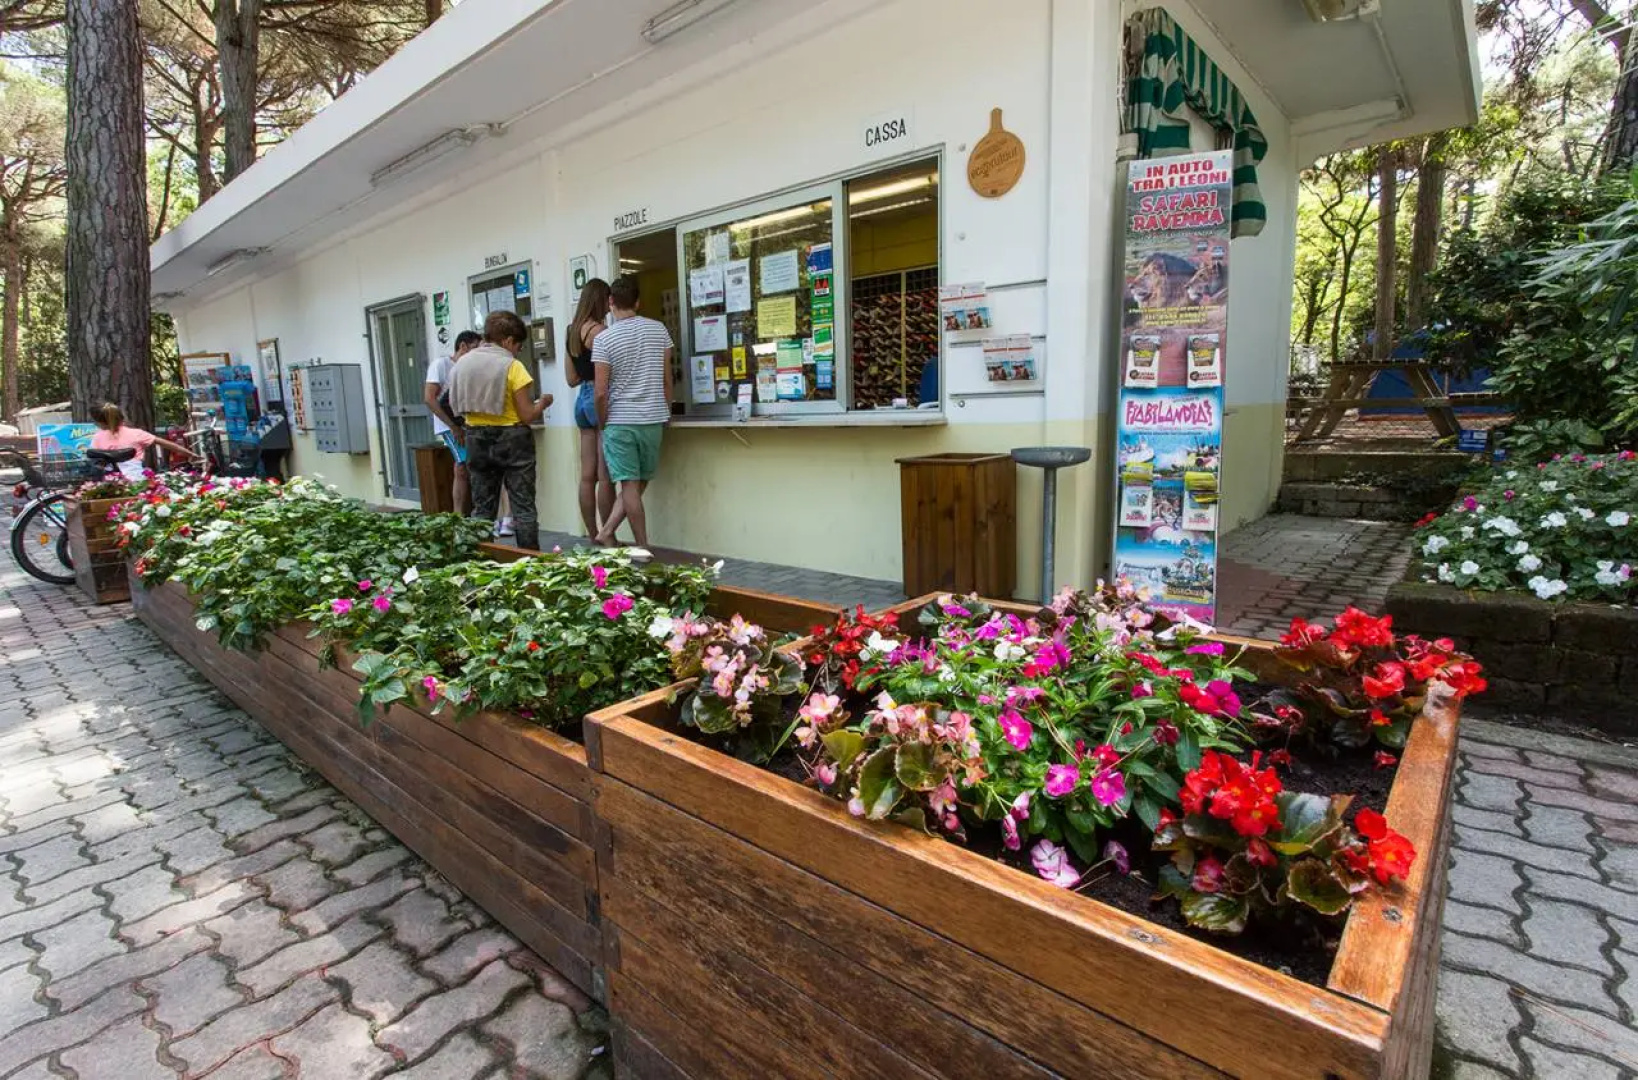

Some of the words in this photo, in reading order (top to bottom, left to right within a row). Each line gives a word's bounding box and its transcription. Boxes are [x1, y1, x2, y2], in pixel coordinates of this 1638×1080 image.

[865, 118, 906, 147] CASSA
[1146, 165, 1164, 178] IN
[1168, 160, 1214, 175] AUTO
[1133, 178, 1165, 192] TRA
[1179, 170, 1227, 187] LEONI
[1140, 190, 1218, 214] SAFARI
[613, 208, 648, 231] PIAZZOLE
[1132, 207, 1224, 231] RAVENNA
